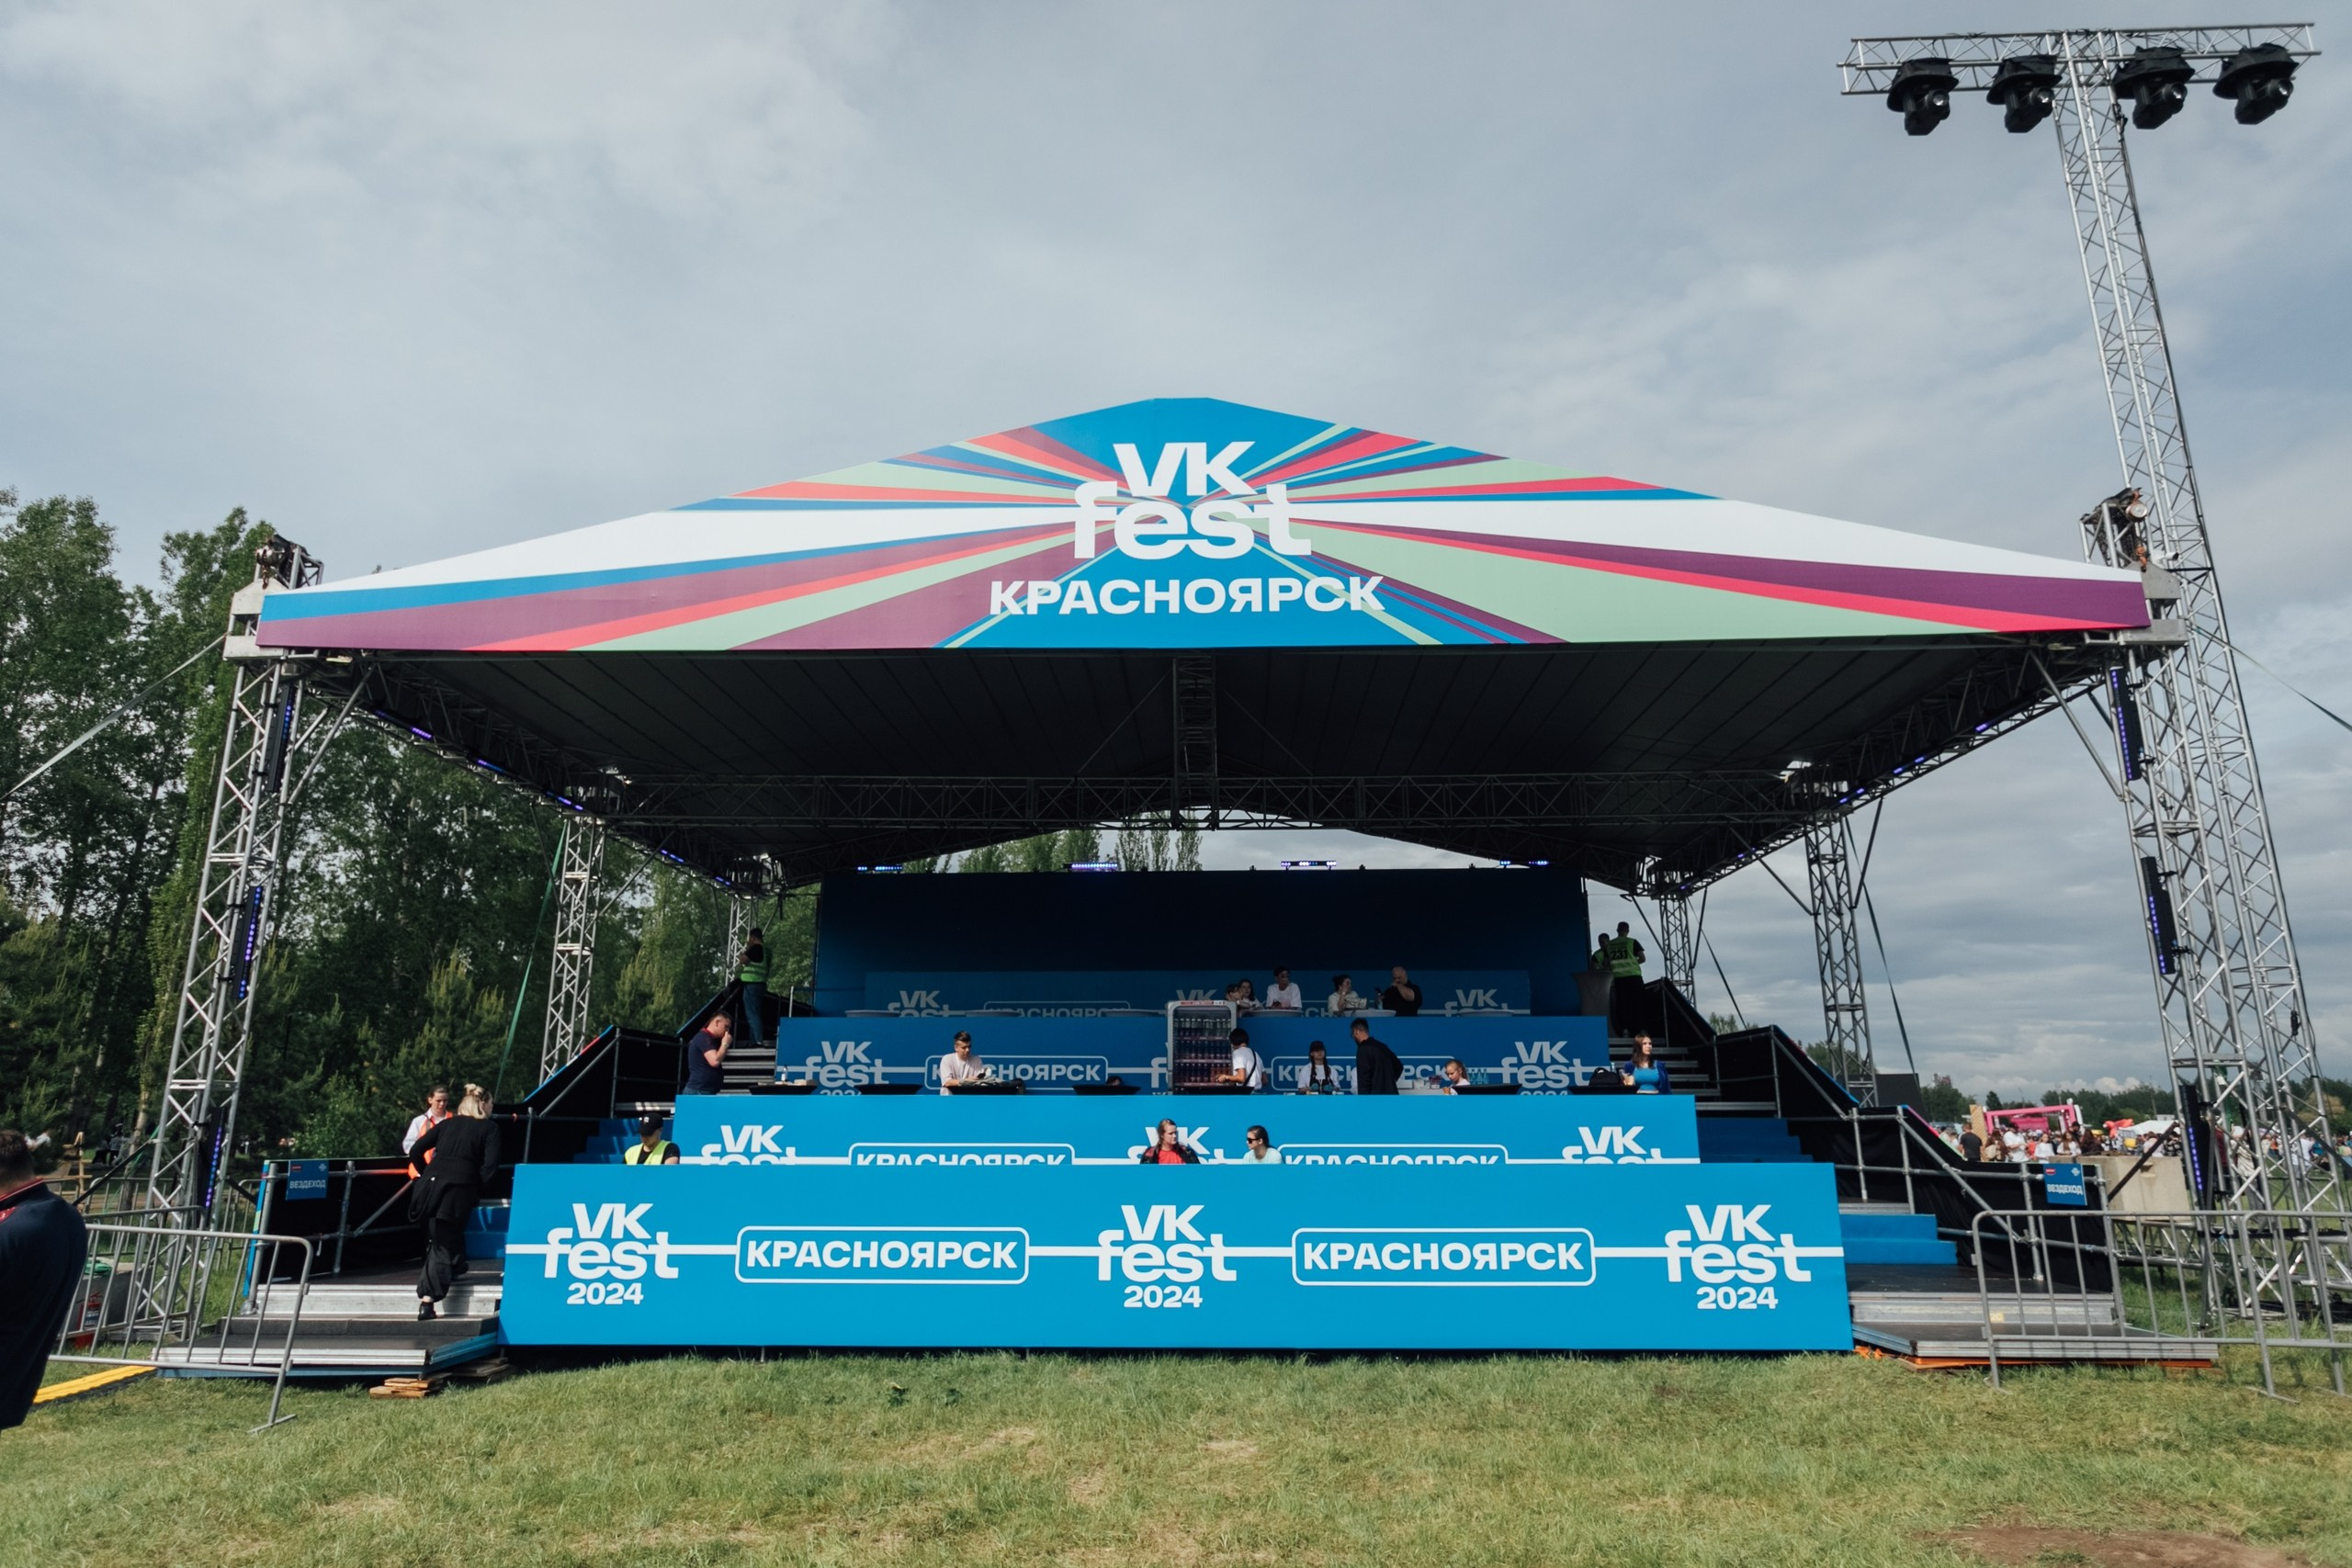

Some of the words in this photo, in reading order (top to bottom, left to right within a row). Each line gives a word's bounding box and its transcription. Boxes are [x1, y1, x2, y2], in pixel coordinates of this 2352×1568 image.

[1113, 441, 1259, 497] VK
[1074, 480, 1312, 559] fest
[989, 576, 1385, 615] КРАСНОЯРСК
[899, 990, 940, 1009] VK
[1455, 988, 1498, 1007] VK
[821, 1041, 872, 1063] VK
[1515, 1041, 1569, 1064] VK
[805, 1055, 889, 1088] fest
[1501, 1056, 1591, 1089] fest
[720, 1125, 784, 1153] VK
[1577, 1126, 1647, 1155] VK
[289, 1179, 326, 1190] ВЕЗДЕХОД
[572, 1203, 653, 1239] VK
[1121, 1204, 1205, 1241] VK
[1685, 1204, 1776, 1241] VK
[544, 1227, 679, 1280] fest
[746, 1240, 1018, 1269] КРАСНОЯРСК
[1098, 1229, 1237, 1282] fest
[1304, 1242, 1584, 1270] КРАСНОЯРСК
[1665, 1229, 1812, 1283] fest
[567, 1282, 644, 1304] 2024
[1124, 1285, 1203, 1308] 2024
[1696, 1286, 1779, 1310] 2024
